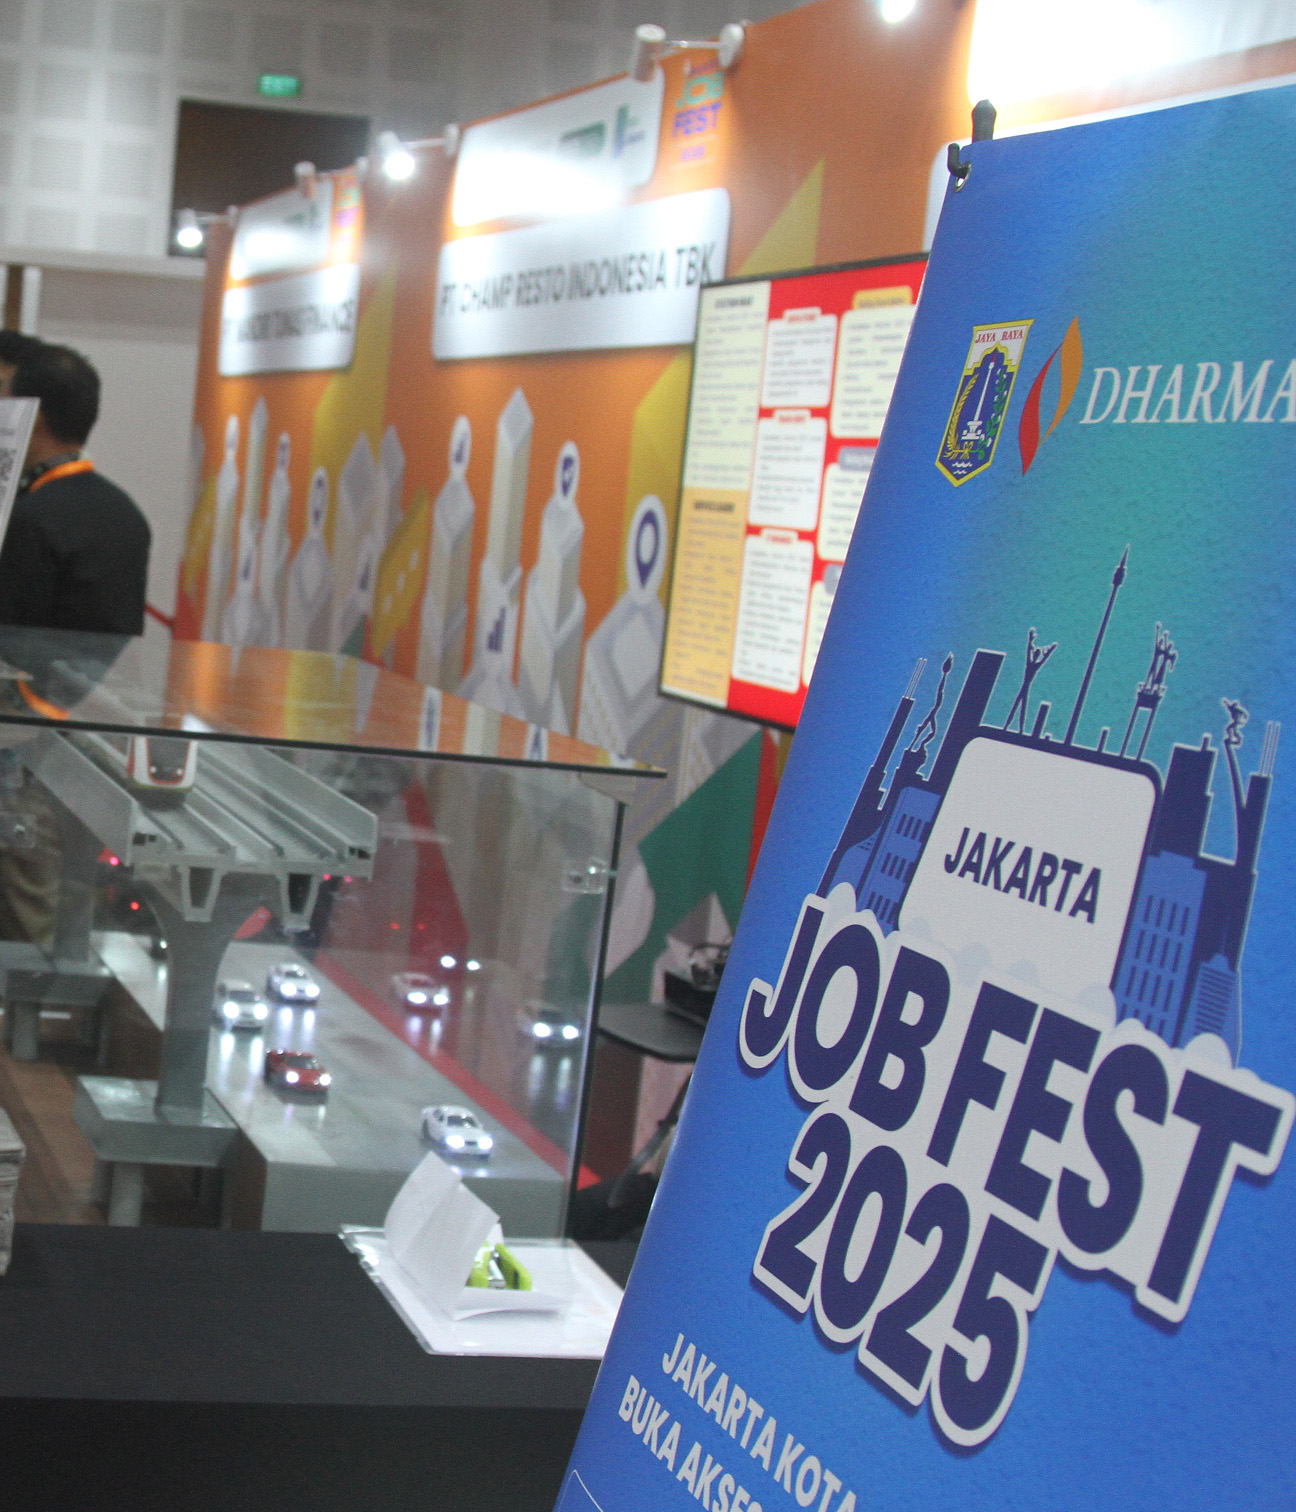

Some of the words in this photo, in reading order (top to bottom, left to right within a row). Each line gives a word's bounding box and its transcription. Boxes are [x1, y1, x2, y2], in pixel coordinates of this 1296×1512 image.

[515, 264, 566, 307] RESTO
[568, 249, 668, 301] INDONESIA
[675, 241, 716, 287] TBK
[975, 332, 996, 343] JAYA
[1001, 329, 1023, 341] RAYA
[1079, 359, 1296, 423] DHARMA
[943, 826, 1103, 926] JAKARTA
[743, 904, 952, 1132] JOB
[926, 980, 1284, 1304] FEST
[759, 1112, 1050, 1432] 2025
[618, 1374, 681, 1472] BUKA
[662, 1332, 777, 1472] JAKARTA
